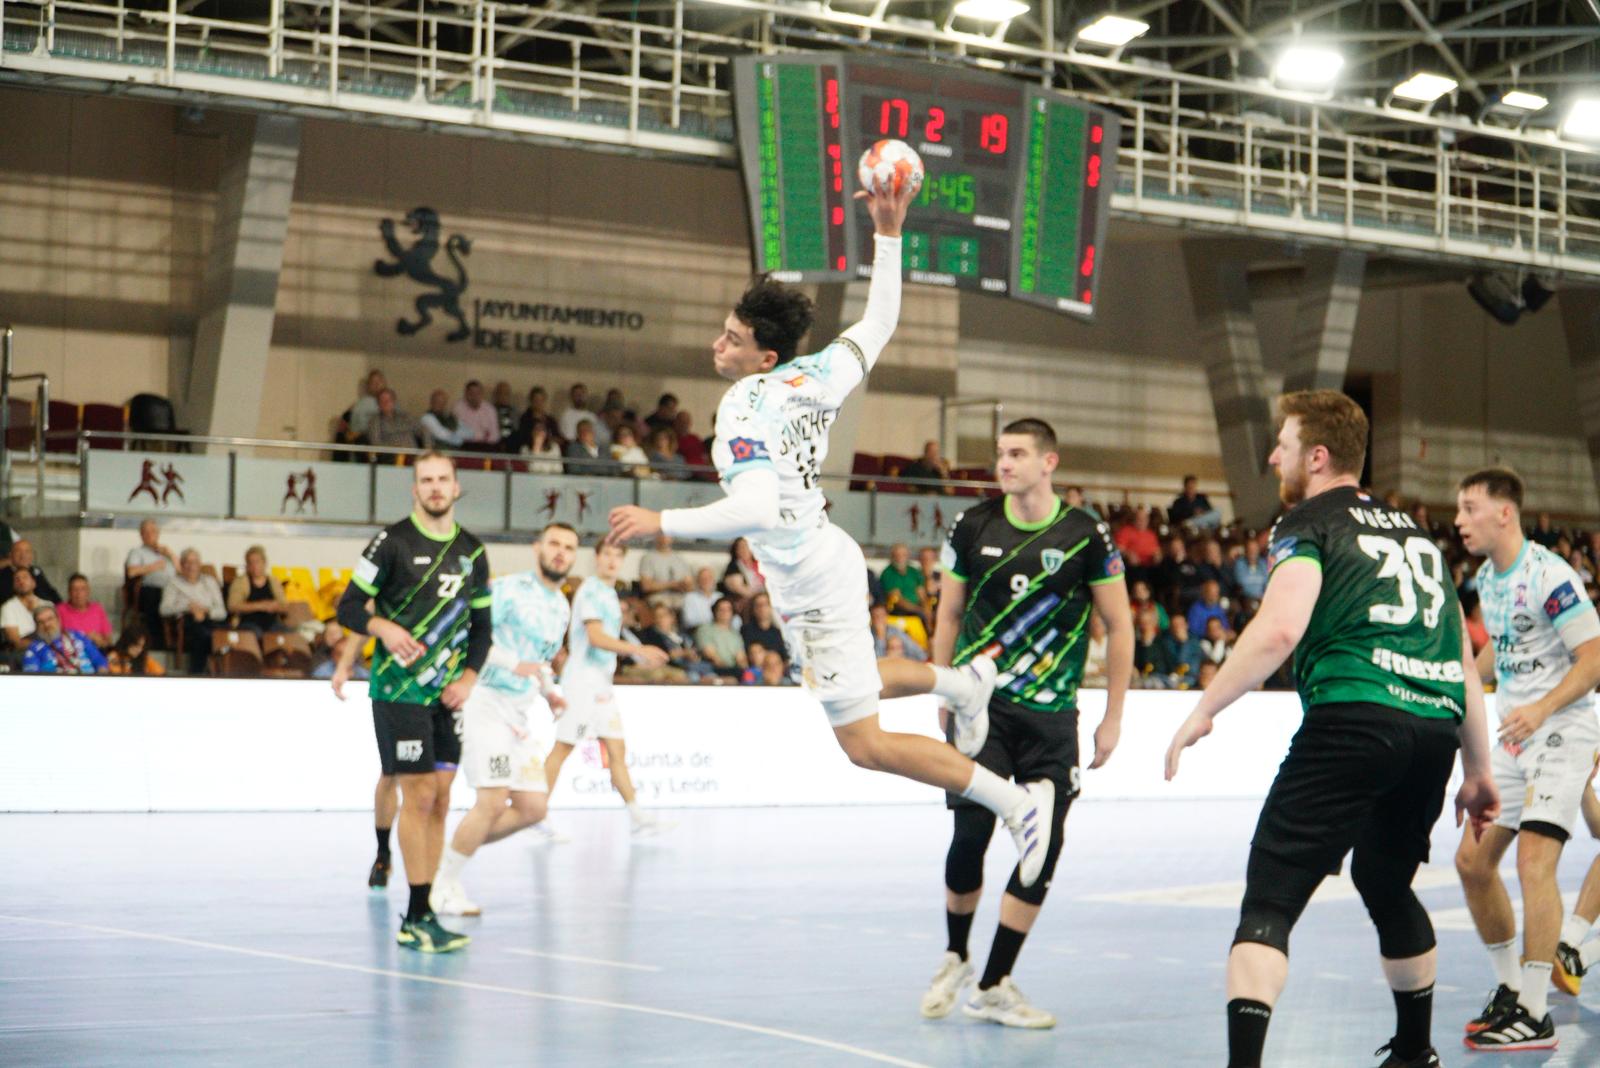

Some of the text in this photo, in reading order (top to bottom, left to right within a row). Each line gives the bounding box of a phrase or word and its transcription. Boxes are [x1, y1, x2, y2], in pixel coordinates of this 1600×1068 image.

[880, 98, 909, 137] 17
[925, 107, 945, 142] 2
[981, 113, 1008, 153] 19
[482, 300, 644, 331] AYUNTAMIENTO
[478, 327, 575, 355] DE LEÓN
[437, 573, 463, 598] 27
[1010, 574, 1029, 600] 9
[1357, 534, 1445, 629] 39
[628, 750, 713, 769] Junta de
[651, 778, 662, 799] y
[669, 774, 720, 794] León
